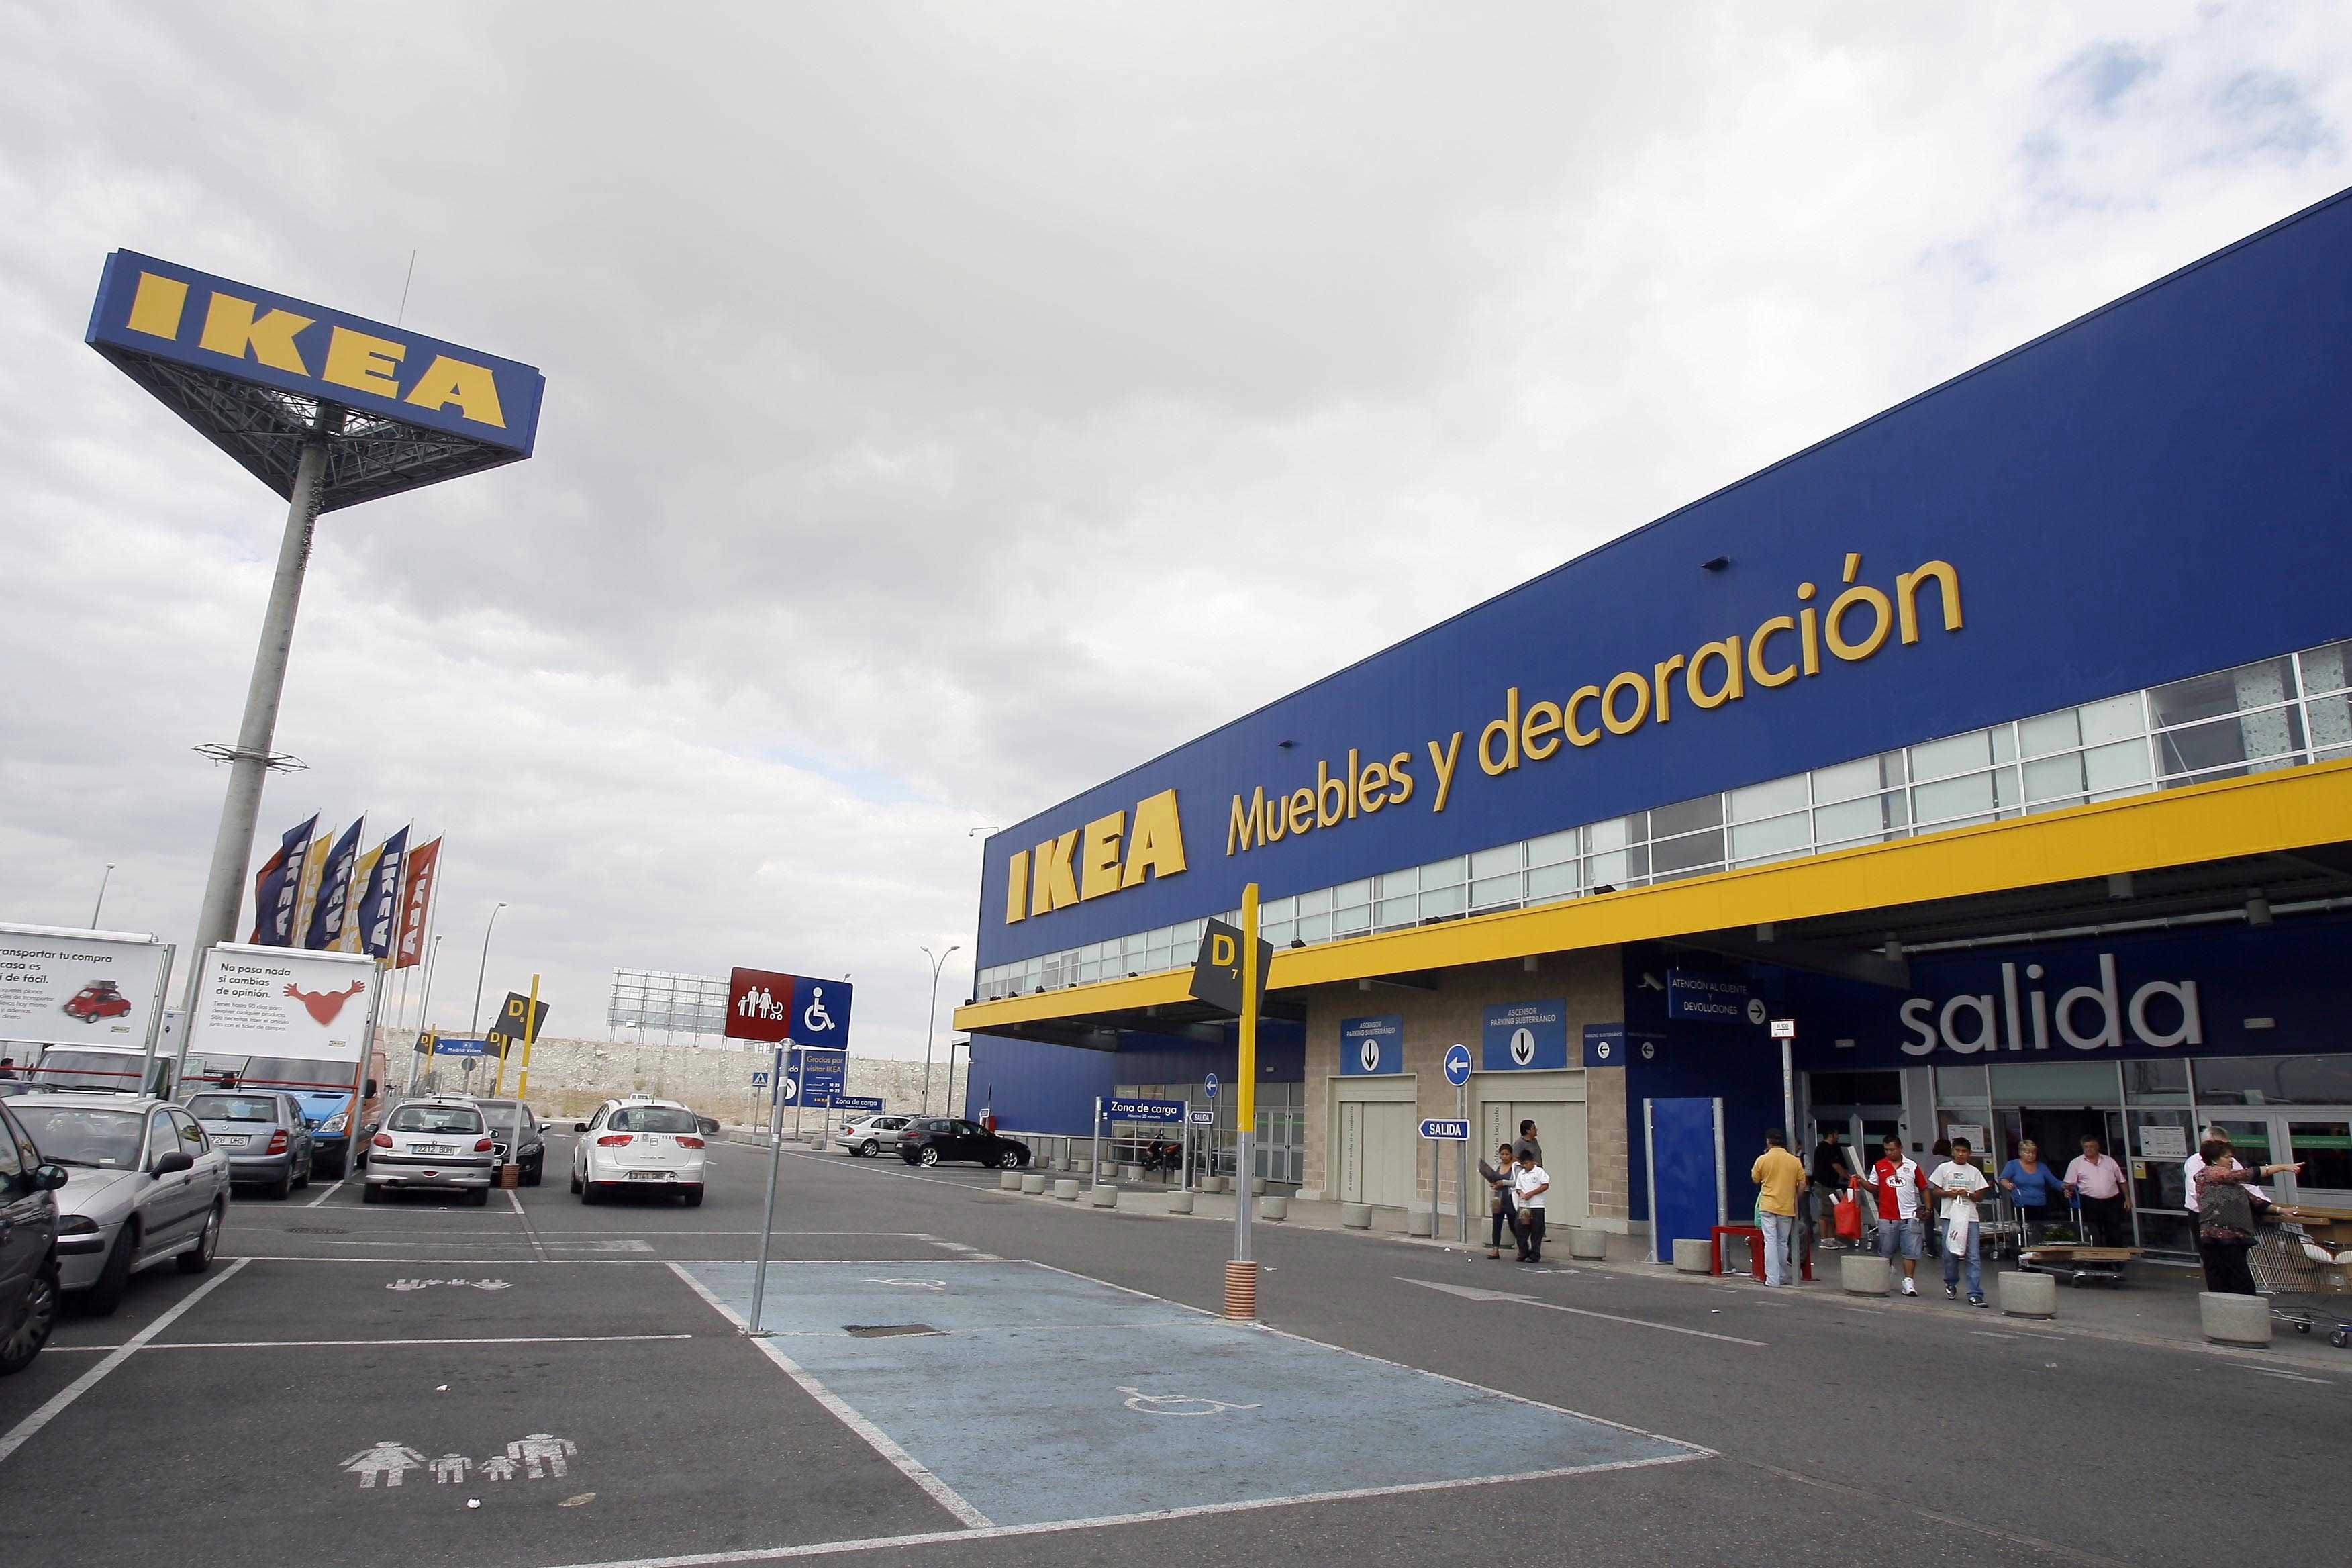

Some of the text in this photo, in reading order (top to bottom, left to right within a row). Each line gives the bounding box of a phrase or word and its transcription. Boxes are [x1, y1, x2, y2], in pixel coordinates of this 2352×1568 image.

[126, 271, 507, 429] IKEA
[1006, 552, 1963, 924] IKEA Muebles y decoración
[276, 840, 309, 936] IKEA
[370, 852, 401, 947] IKEA
[0, 948, 113, 963] ransportar tu compra
[1212, 934, 1235, 966] D
[0, 961, 26, 970] casa
[220, 963, 291, 977] No pasa nada
[5, 973, 19, 981] de
[23, 974, 49, 984] fácil.
[1232, 969, 1238, 979] 7
[218, 975, 270, 987] si cambias
[216, 987, 271, 999] de opinión.
[1710, 982, 1719, 991] AL
[1720, 983, 1748, 994] CLIENTE
[508, 999, 524, 1017] D
[1683, 1001, 1738, 1015] DEVOLUCIONES
[1900, 953, 2202, 1056] salida
[1508, 1007, 1537, 1016] ASCENSOR
[1359, 1021, 1382, 1029] ASCENSOR
[1490, 1017, 1515, 1026] PARKING
[490, 1032, 500, 1043] D
[1346, 1029, 1365, 1037] PARKING
[420, 1036, 428, 1044] D
[806, 1055, 844, 1065] Gracias por
[806, 1065, 825, 1073] visitar
[826, 1065, 842, 1073] IKEA
[835, 1097, 850, 1106] Zona
[1111, 1101, 1177, 1116] Zona de carga
[1194, 1114, 1209, 1122] SALIDA
[1429, 1123, 1462, 1136] SALIDA
[1494, 1138, 1499, 1148] de
[417, 1145, 435, 1153] 2212
